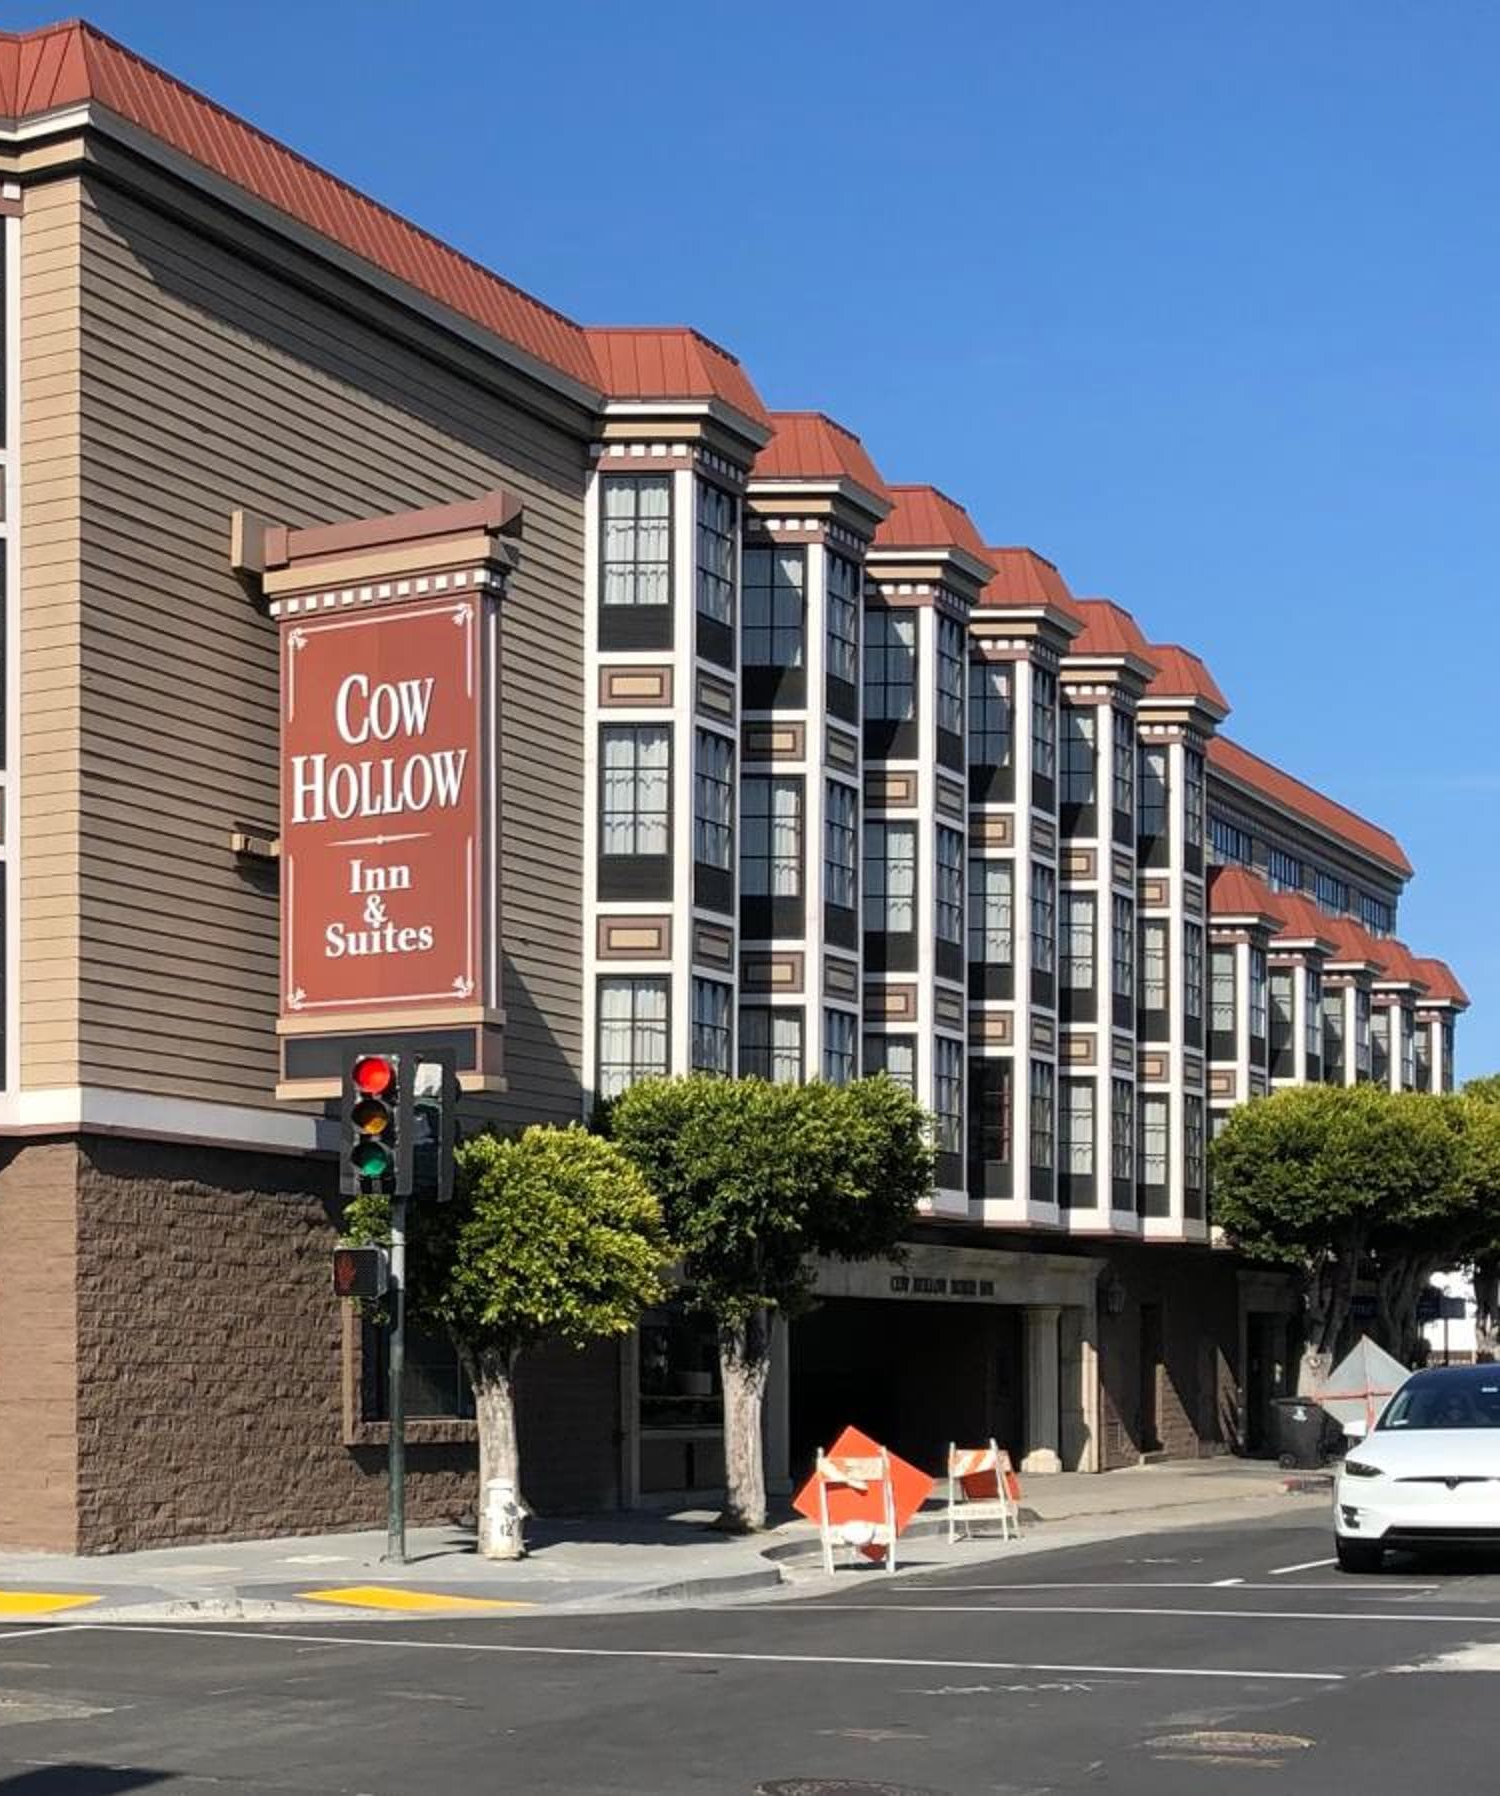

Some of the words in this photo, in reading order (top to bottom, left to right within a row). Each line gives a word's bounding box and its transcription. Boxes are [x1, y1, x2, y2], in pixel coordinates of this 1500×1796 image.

[350, 859, 411, 894] Inn
[363, 894, 388, 926] &
[324, 922, 435, 959] Suites
